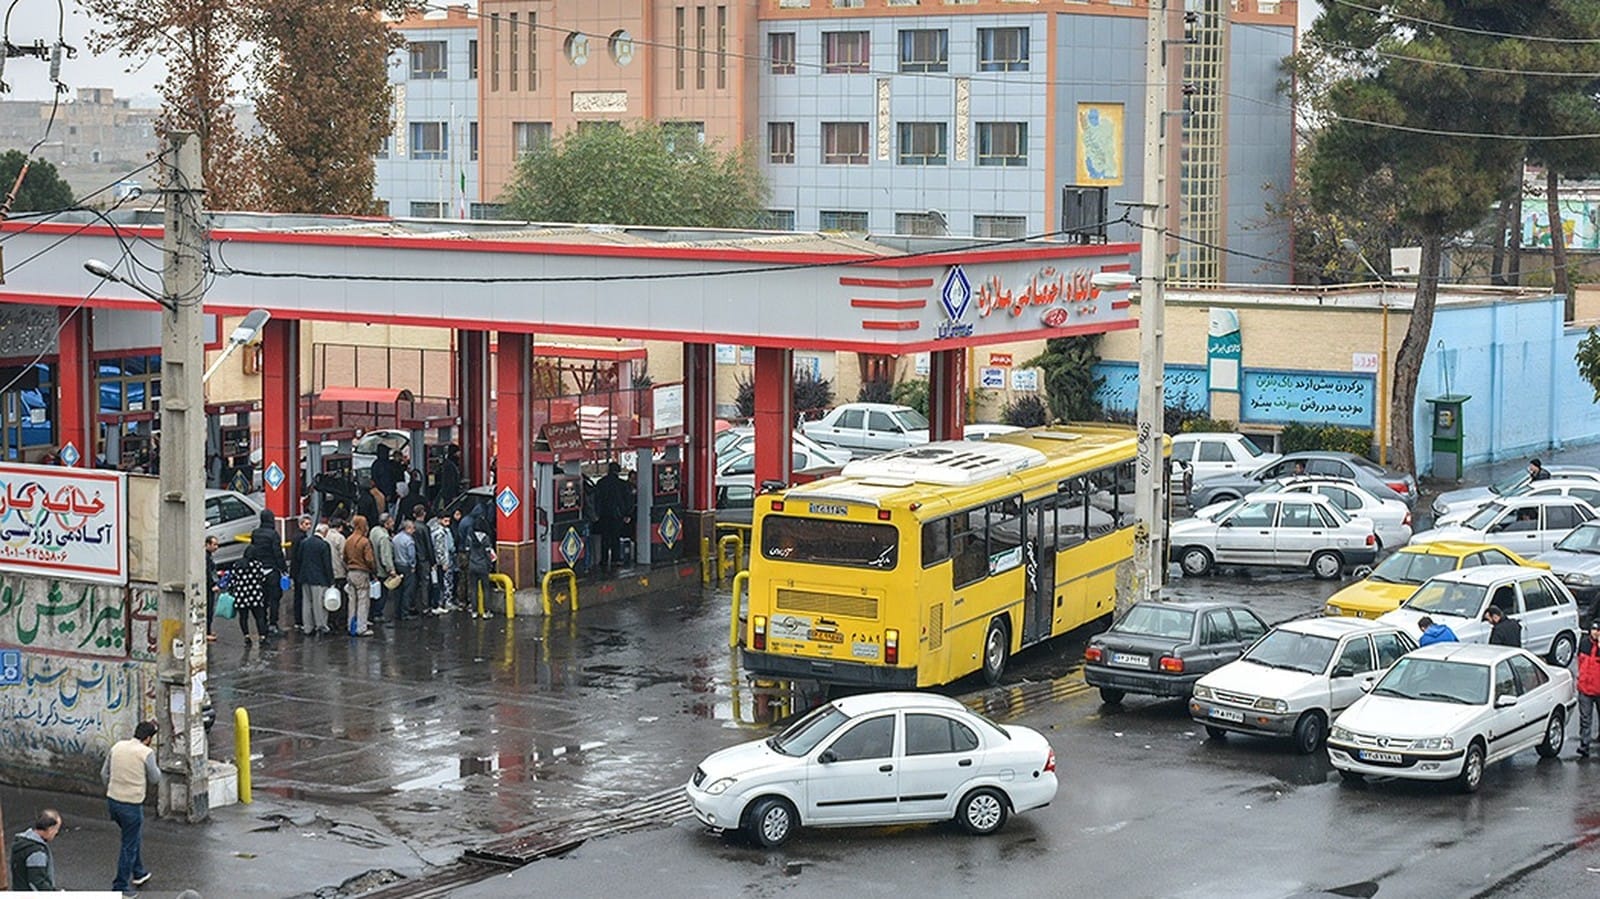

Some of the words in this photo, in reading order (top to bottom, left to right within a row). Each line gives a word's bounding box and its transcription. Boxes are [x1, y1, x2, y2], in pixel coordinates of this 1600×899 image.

[42, 488, 105, 515] خانه
[0, 521, 53, 546] ورزشی
[56, 524, 113, 547] آکادمی
